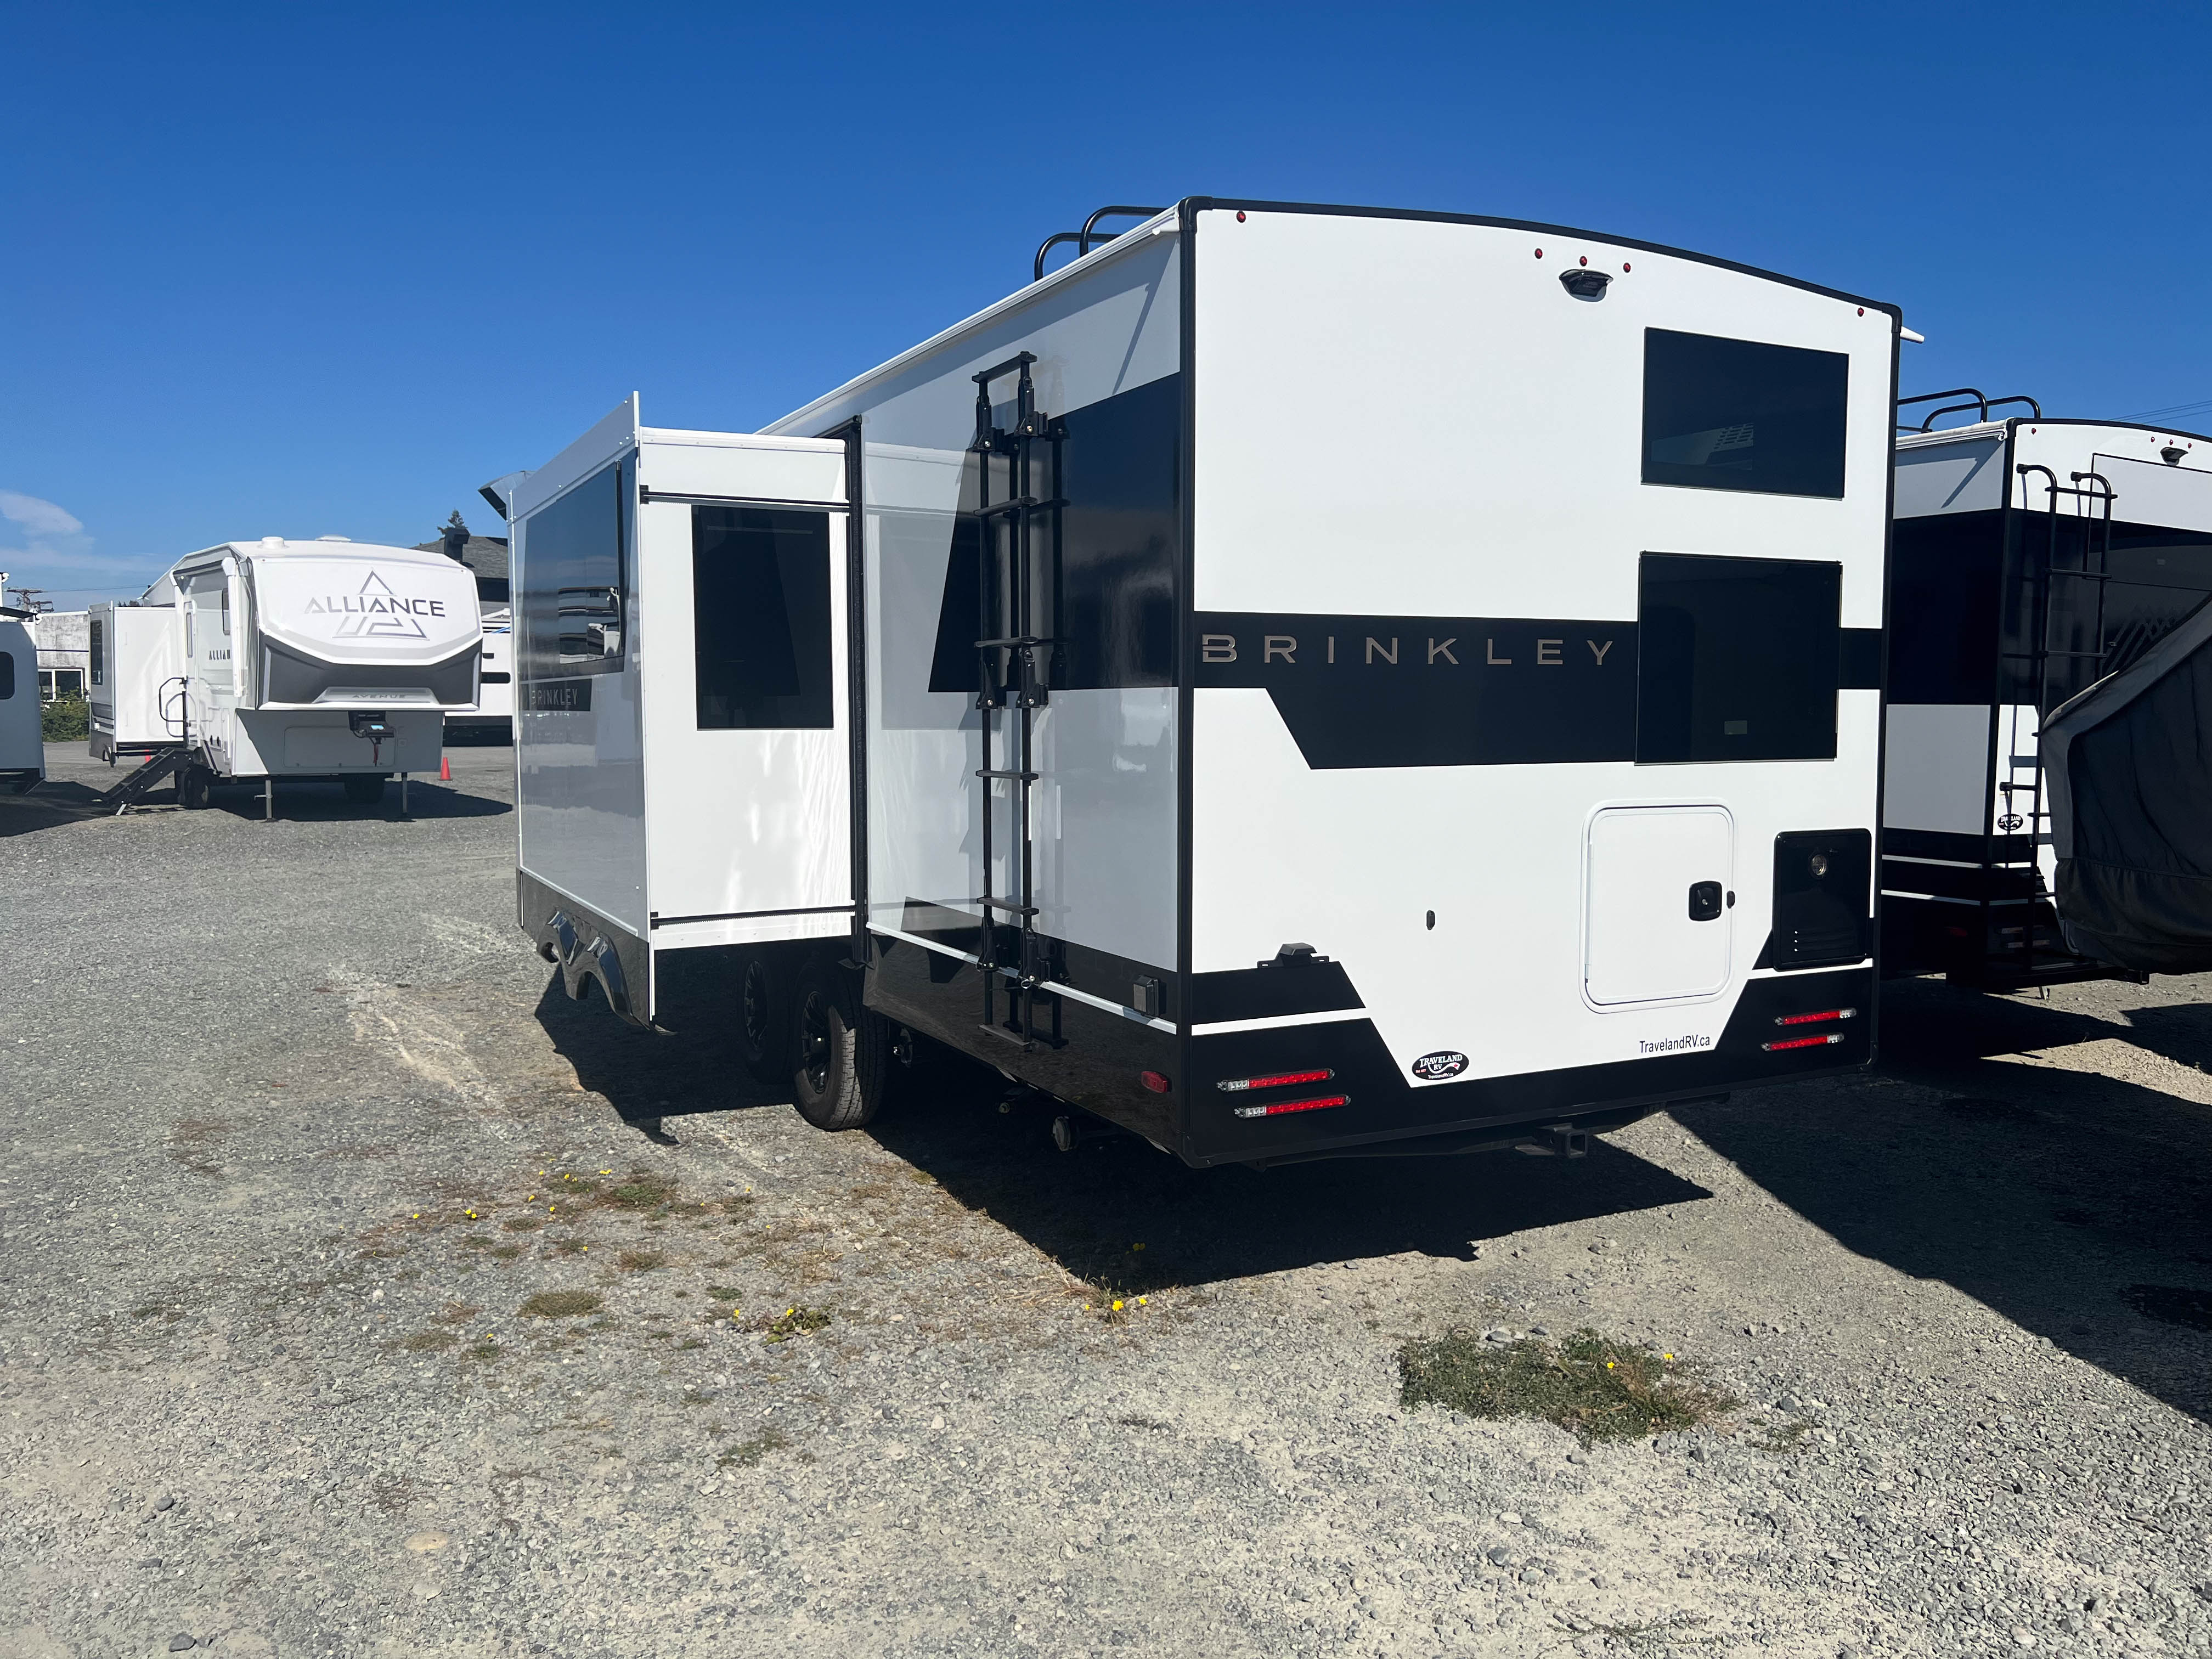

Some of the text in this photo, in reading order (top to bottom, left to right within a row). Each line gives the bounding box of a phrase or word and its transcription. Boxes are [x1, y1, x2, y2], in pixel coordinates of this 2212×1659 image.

[303, 596, 446, 618] ALLIANCE
[209, 650, 231, 661] ALLIAN
[1201, 633, 1614, 665] BRINKLEY
[531, 688, 579, 706] BRINKLEY
[1639, 1034, 1711, 1053] TravelandRV.ca
[1419, 1054, 1462, 1068] TRAVELAND
